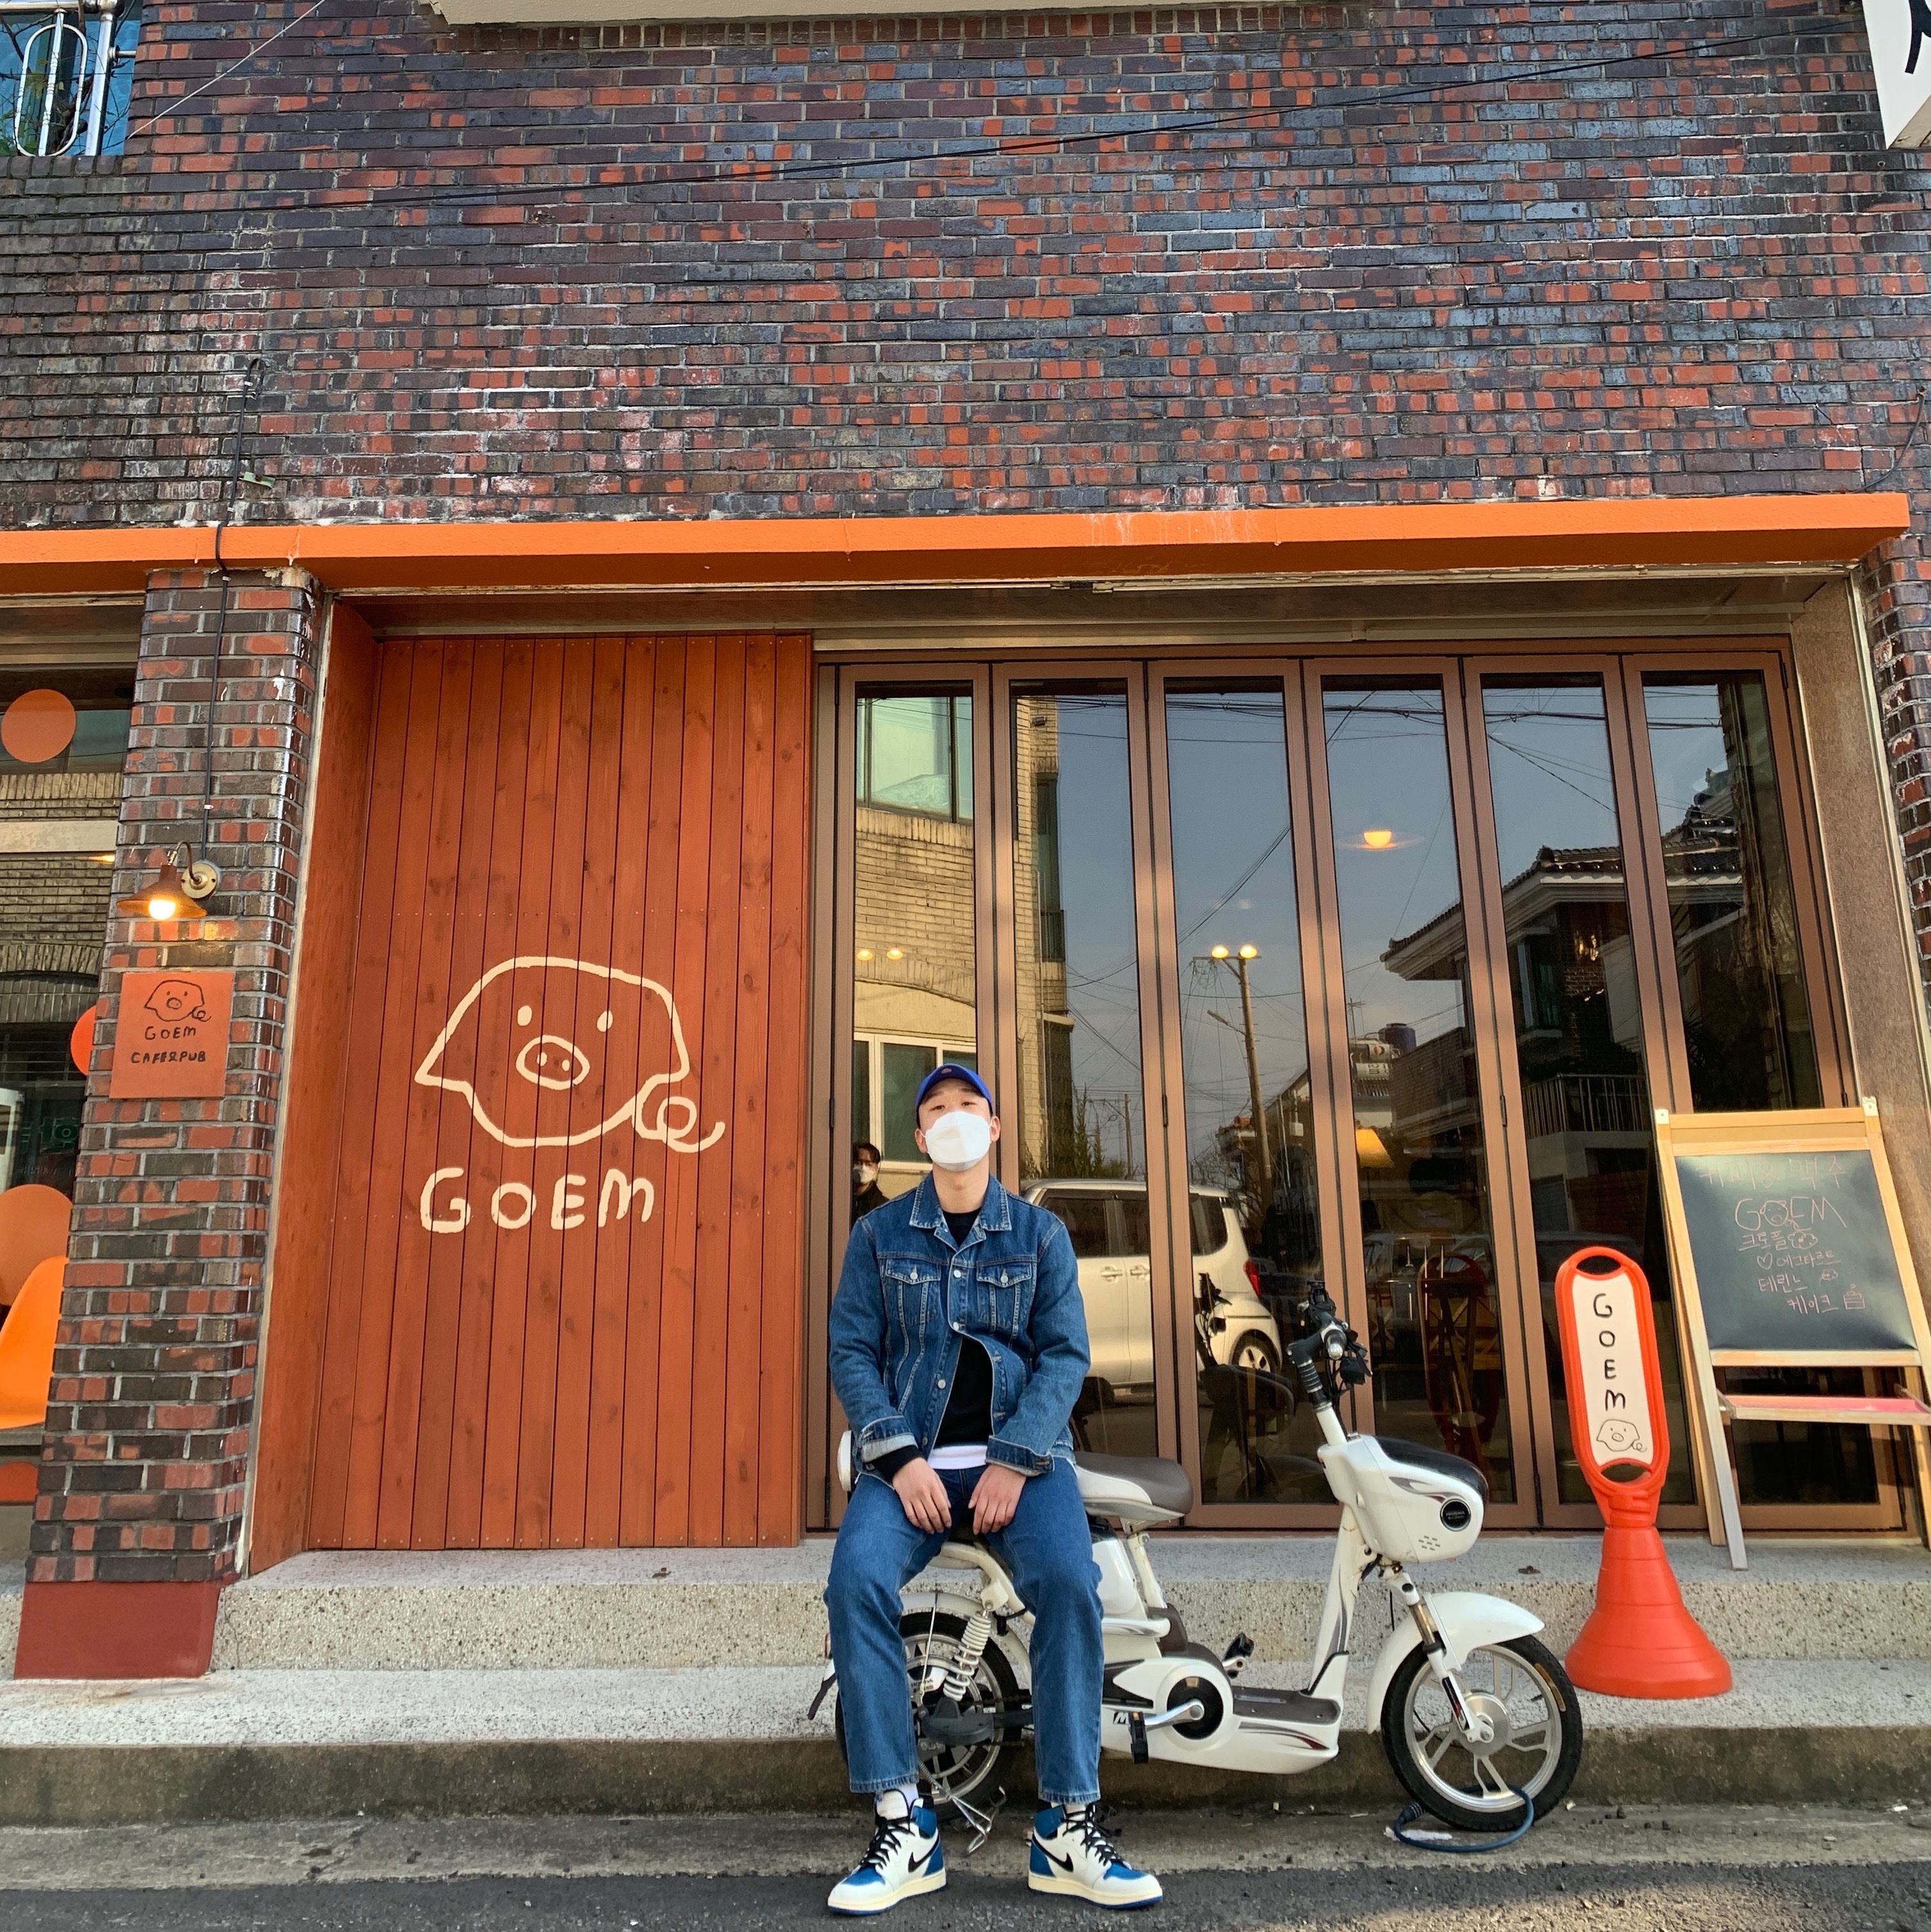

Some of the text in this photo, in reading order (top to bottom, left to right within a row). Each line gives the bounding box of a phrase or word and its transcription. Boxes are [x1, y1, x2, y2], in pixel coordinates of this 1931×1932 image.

[144, 1026, 196, 1040] GOEM
[130, 1051, 206, 1064] CAFE&PUB
[420, 1167, 655, 1233] GOEM
[1734, 1196, 1847, 1231] GOEM
[1776, 1251, 1841, 1269] 에그타르트
[1758, 1273, 1808, 1293] 테린느
[1787, 1294, 1839, 1315] 케이크
[1593, 1292, 1626, 1411] GOEM
